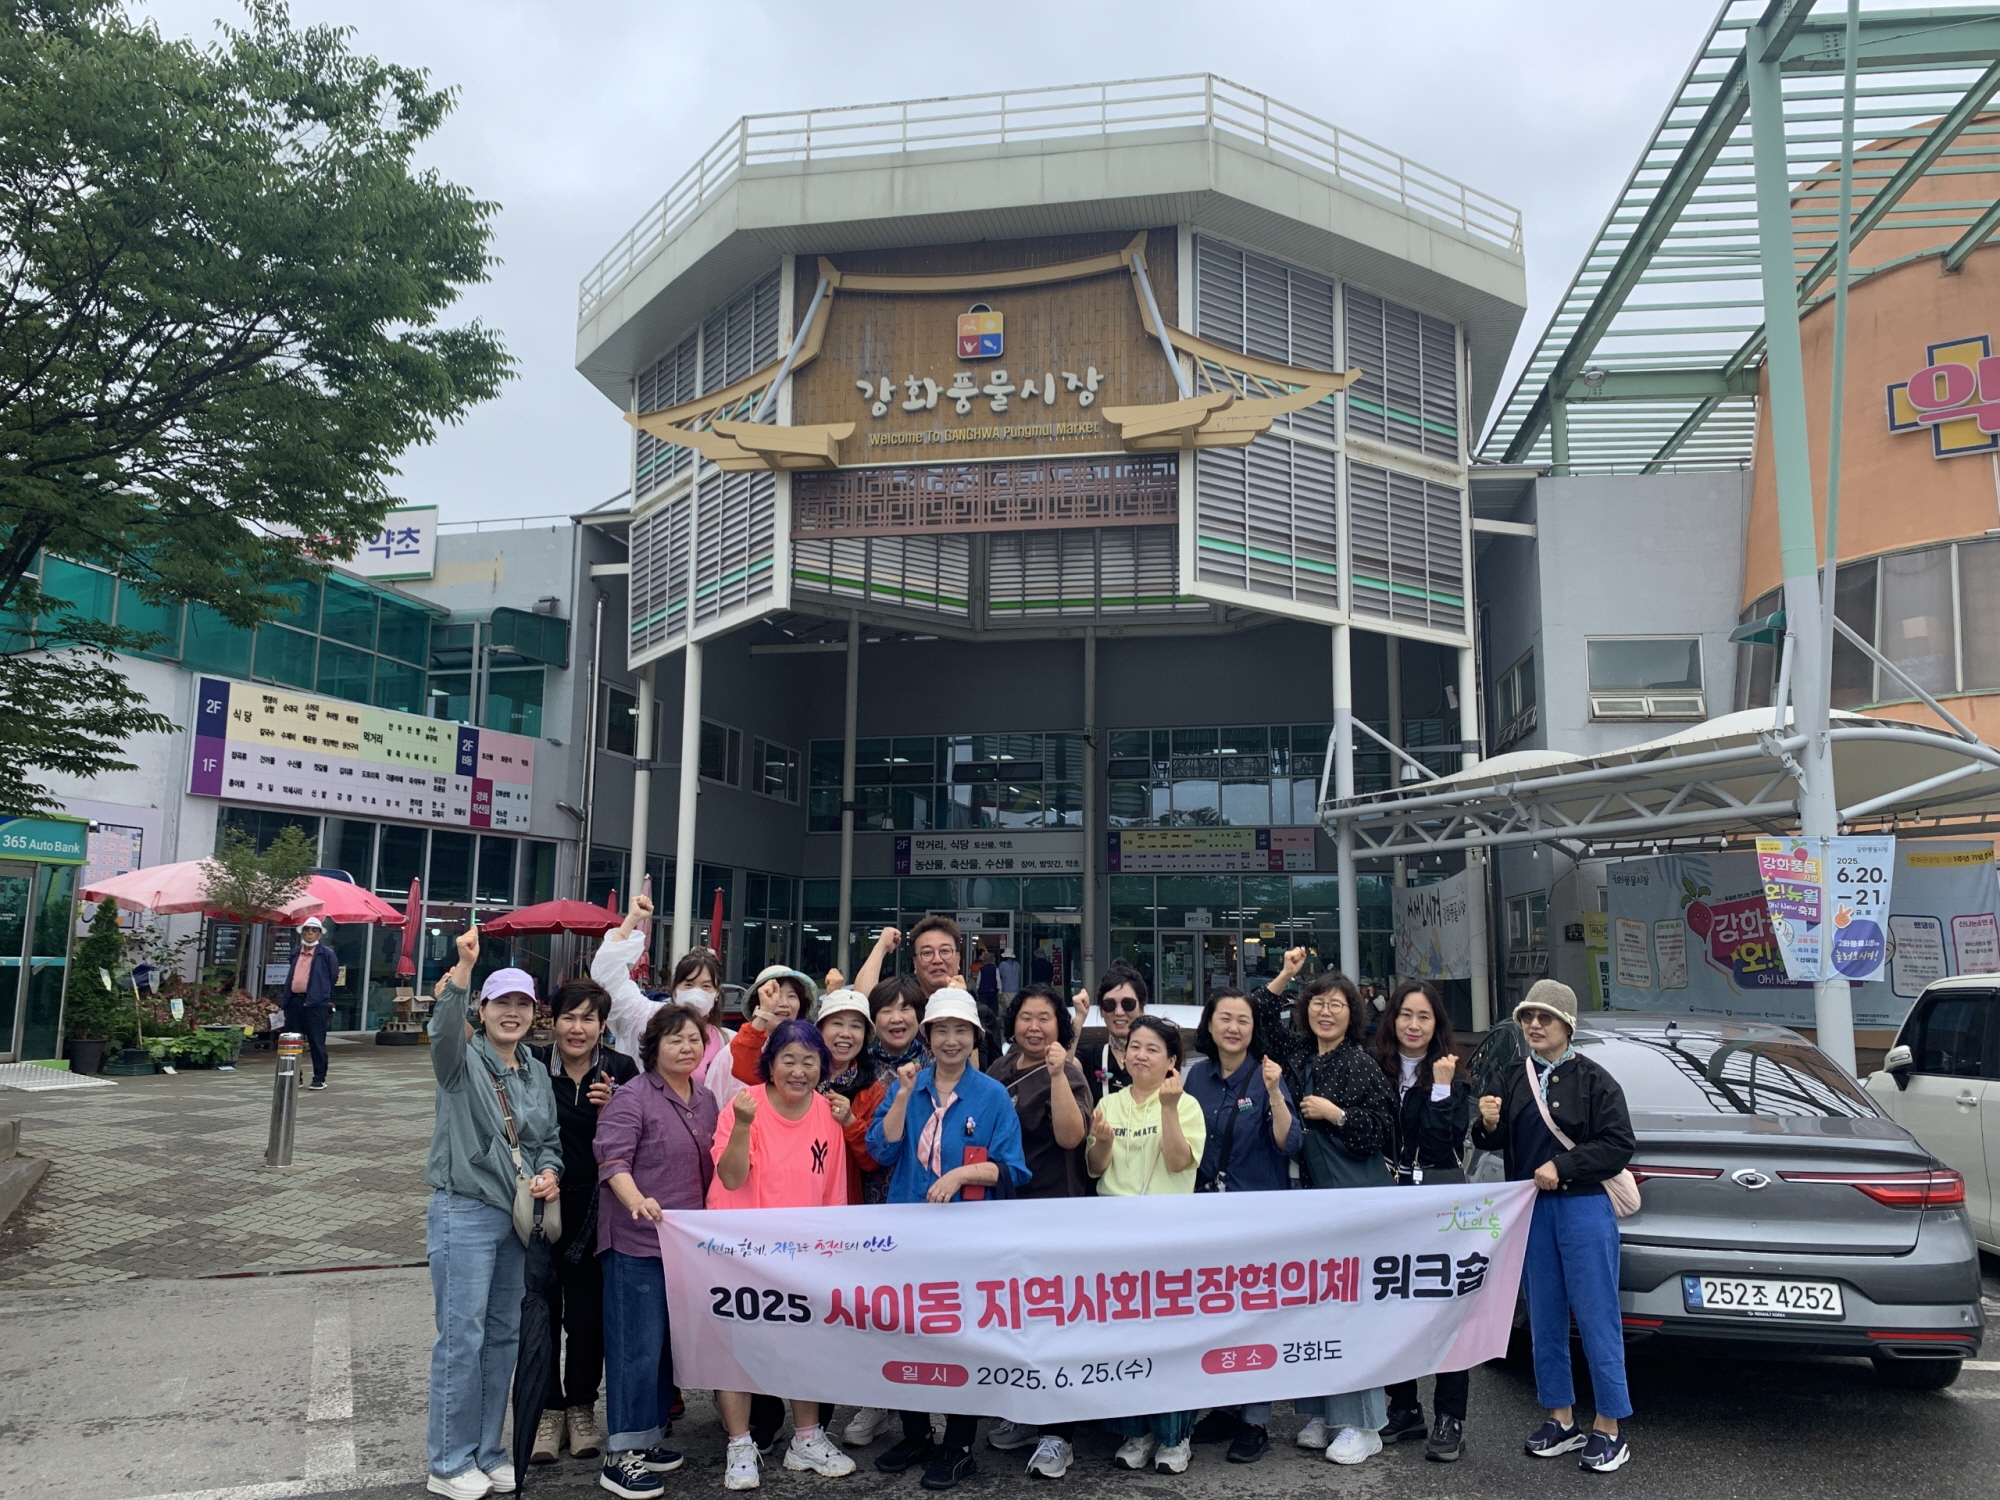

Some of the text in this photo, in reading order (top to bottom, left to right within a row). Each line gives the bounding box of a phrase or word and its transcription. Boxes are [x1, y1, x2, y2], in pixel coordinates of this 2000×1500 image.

[856, 366, 1104, 417] 강화풍물시장
[870, 422, 1099, 445] Welcome To GANGHWA Pungmul Market
[368, 526, 420, 559] 약초
[206, 699, 222, 714] 2F
[363, 731, 383, 745] 먹거리
[462, 738, 474, 752] 2F
[202, 758, 218, 772] 1F
[2, 834, 80, 854] 365 Auto Bank
[896, 839, 909, 850] 2F
[915, 840, 947, 851] 먹거리,
[950, 840, 970, 850] 식당
[896, 860, 908, 870] 1F
[915, 860, 946, 870] 농산물,
[950, 859, 982, 870] 축산물,
[984, 858, 1014, 869] 수산물
[1020, 860, 1038, 868] 장어,
[1065, 860, 1080, 868] 약초
[1762, 856, 1818, 873] 강화풍물
[1836, 867, 1888, 883] 6.20.
[1798, 906, 1817, 917] 축제
[1133, 1126, 1158, 1138] MATE
[1438, 1206, 1502, 1239] 사이동
[770, 1241, 810, 1261] 자유로운
[814, 1239, 858, 1259] 혁신도시
[862, 1236, 898, 1253] 안산
[710, 1252, 1490, 1336] 2025 사이동 지역사회보장협의체 워크숍
[1704, 1282, 1835, 1310] 252조 4252
[1283, 1340, 1342, 1362] 강화도
[977, 1366, 1046, 1390] 2025.
[1054, 1366, 1073, 1388] 6.
[1081, 1357, 1153, 1385] 25.(수)
